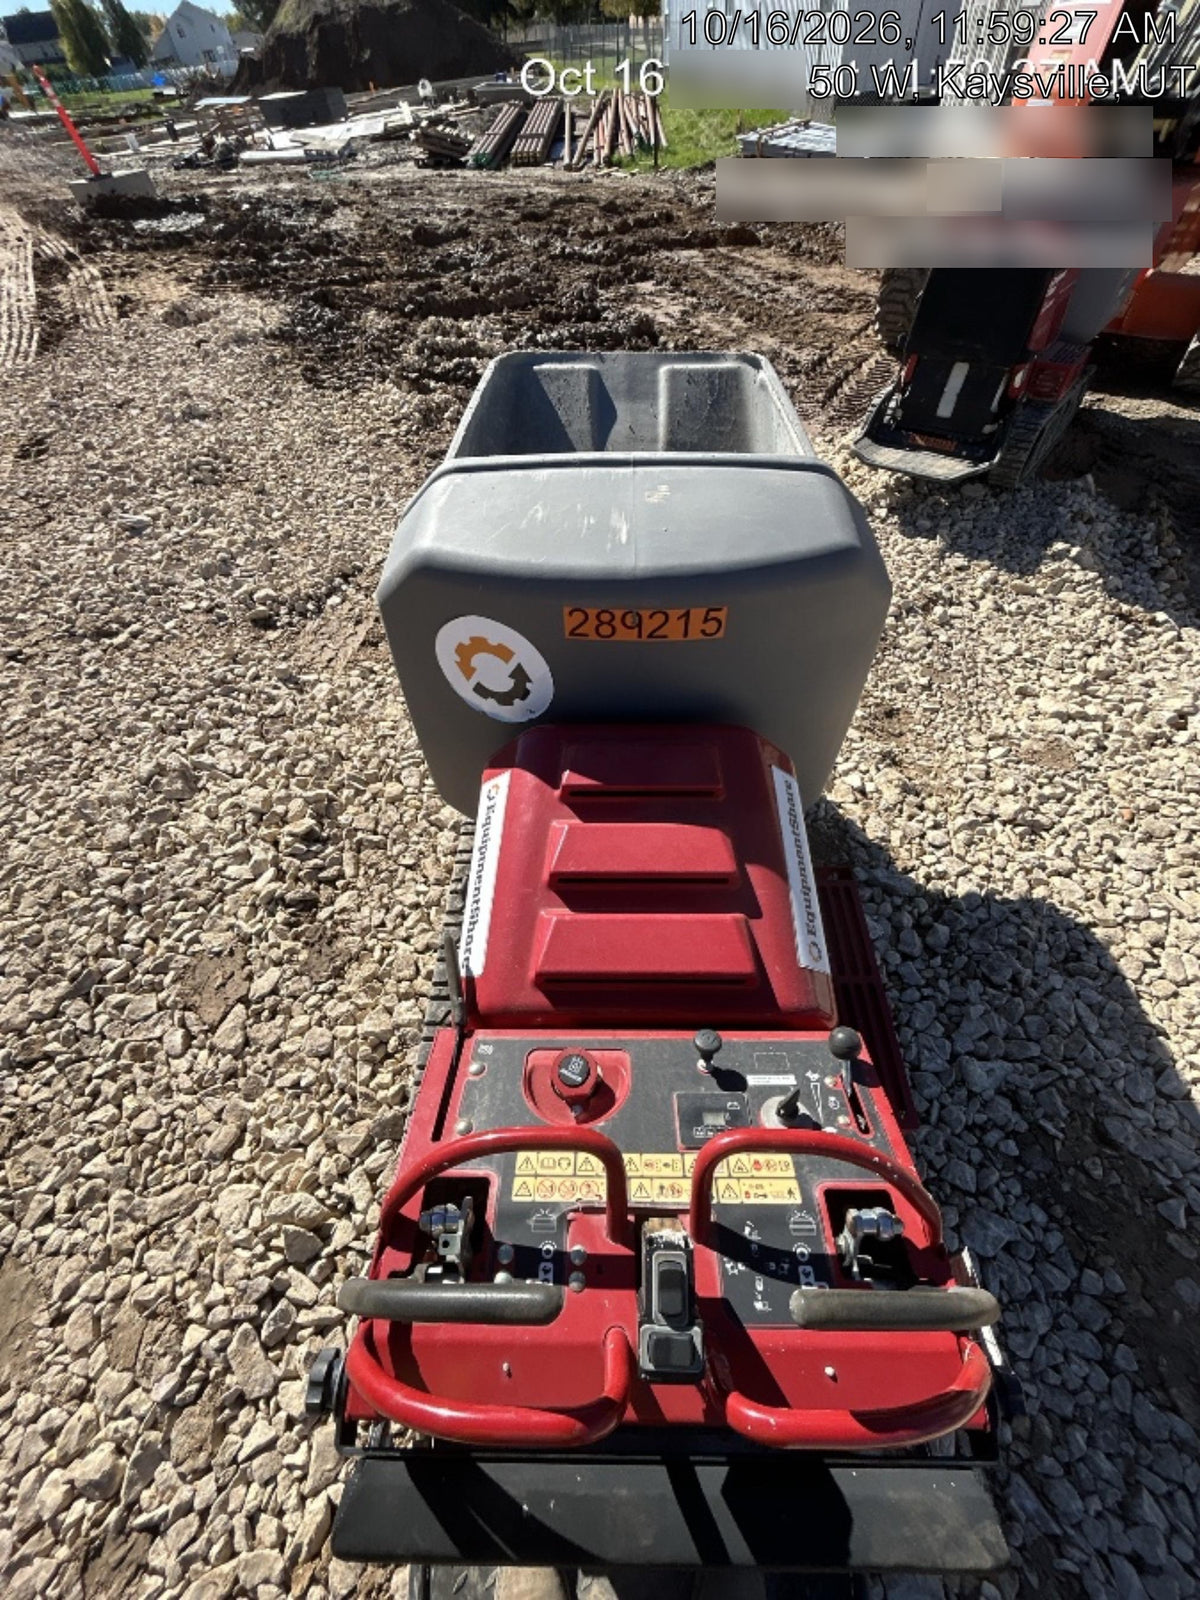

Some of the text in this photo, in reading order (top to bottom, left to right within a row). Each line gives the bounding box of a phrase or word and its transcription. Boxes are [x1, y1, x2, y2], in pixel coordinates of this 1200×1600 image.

[567, 607, 724, 639] 289215
[461, 803, 498, 970] EquipmentShare
[784, 779, 818, 938] EquipmentShare
